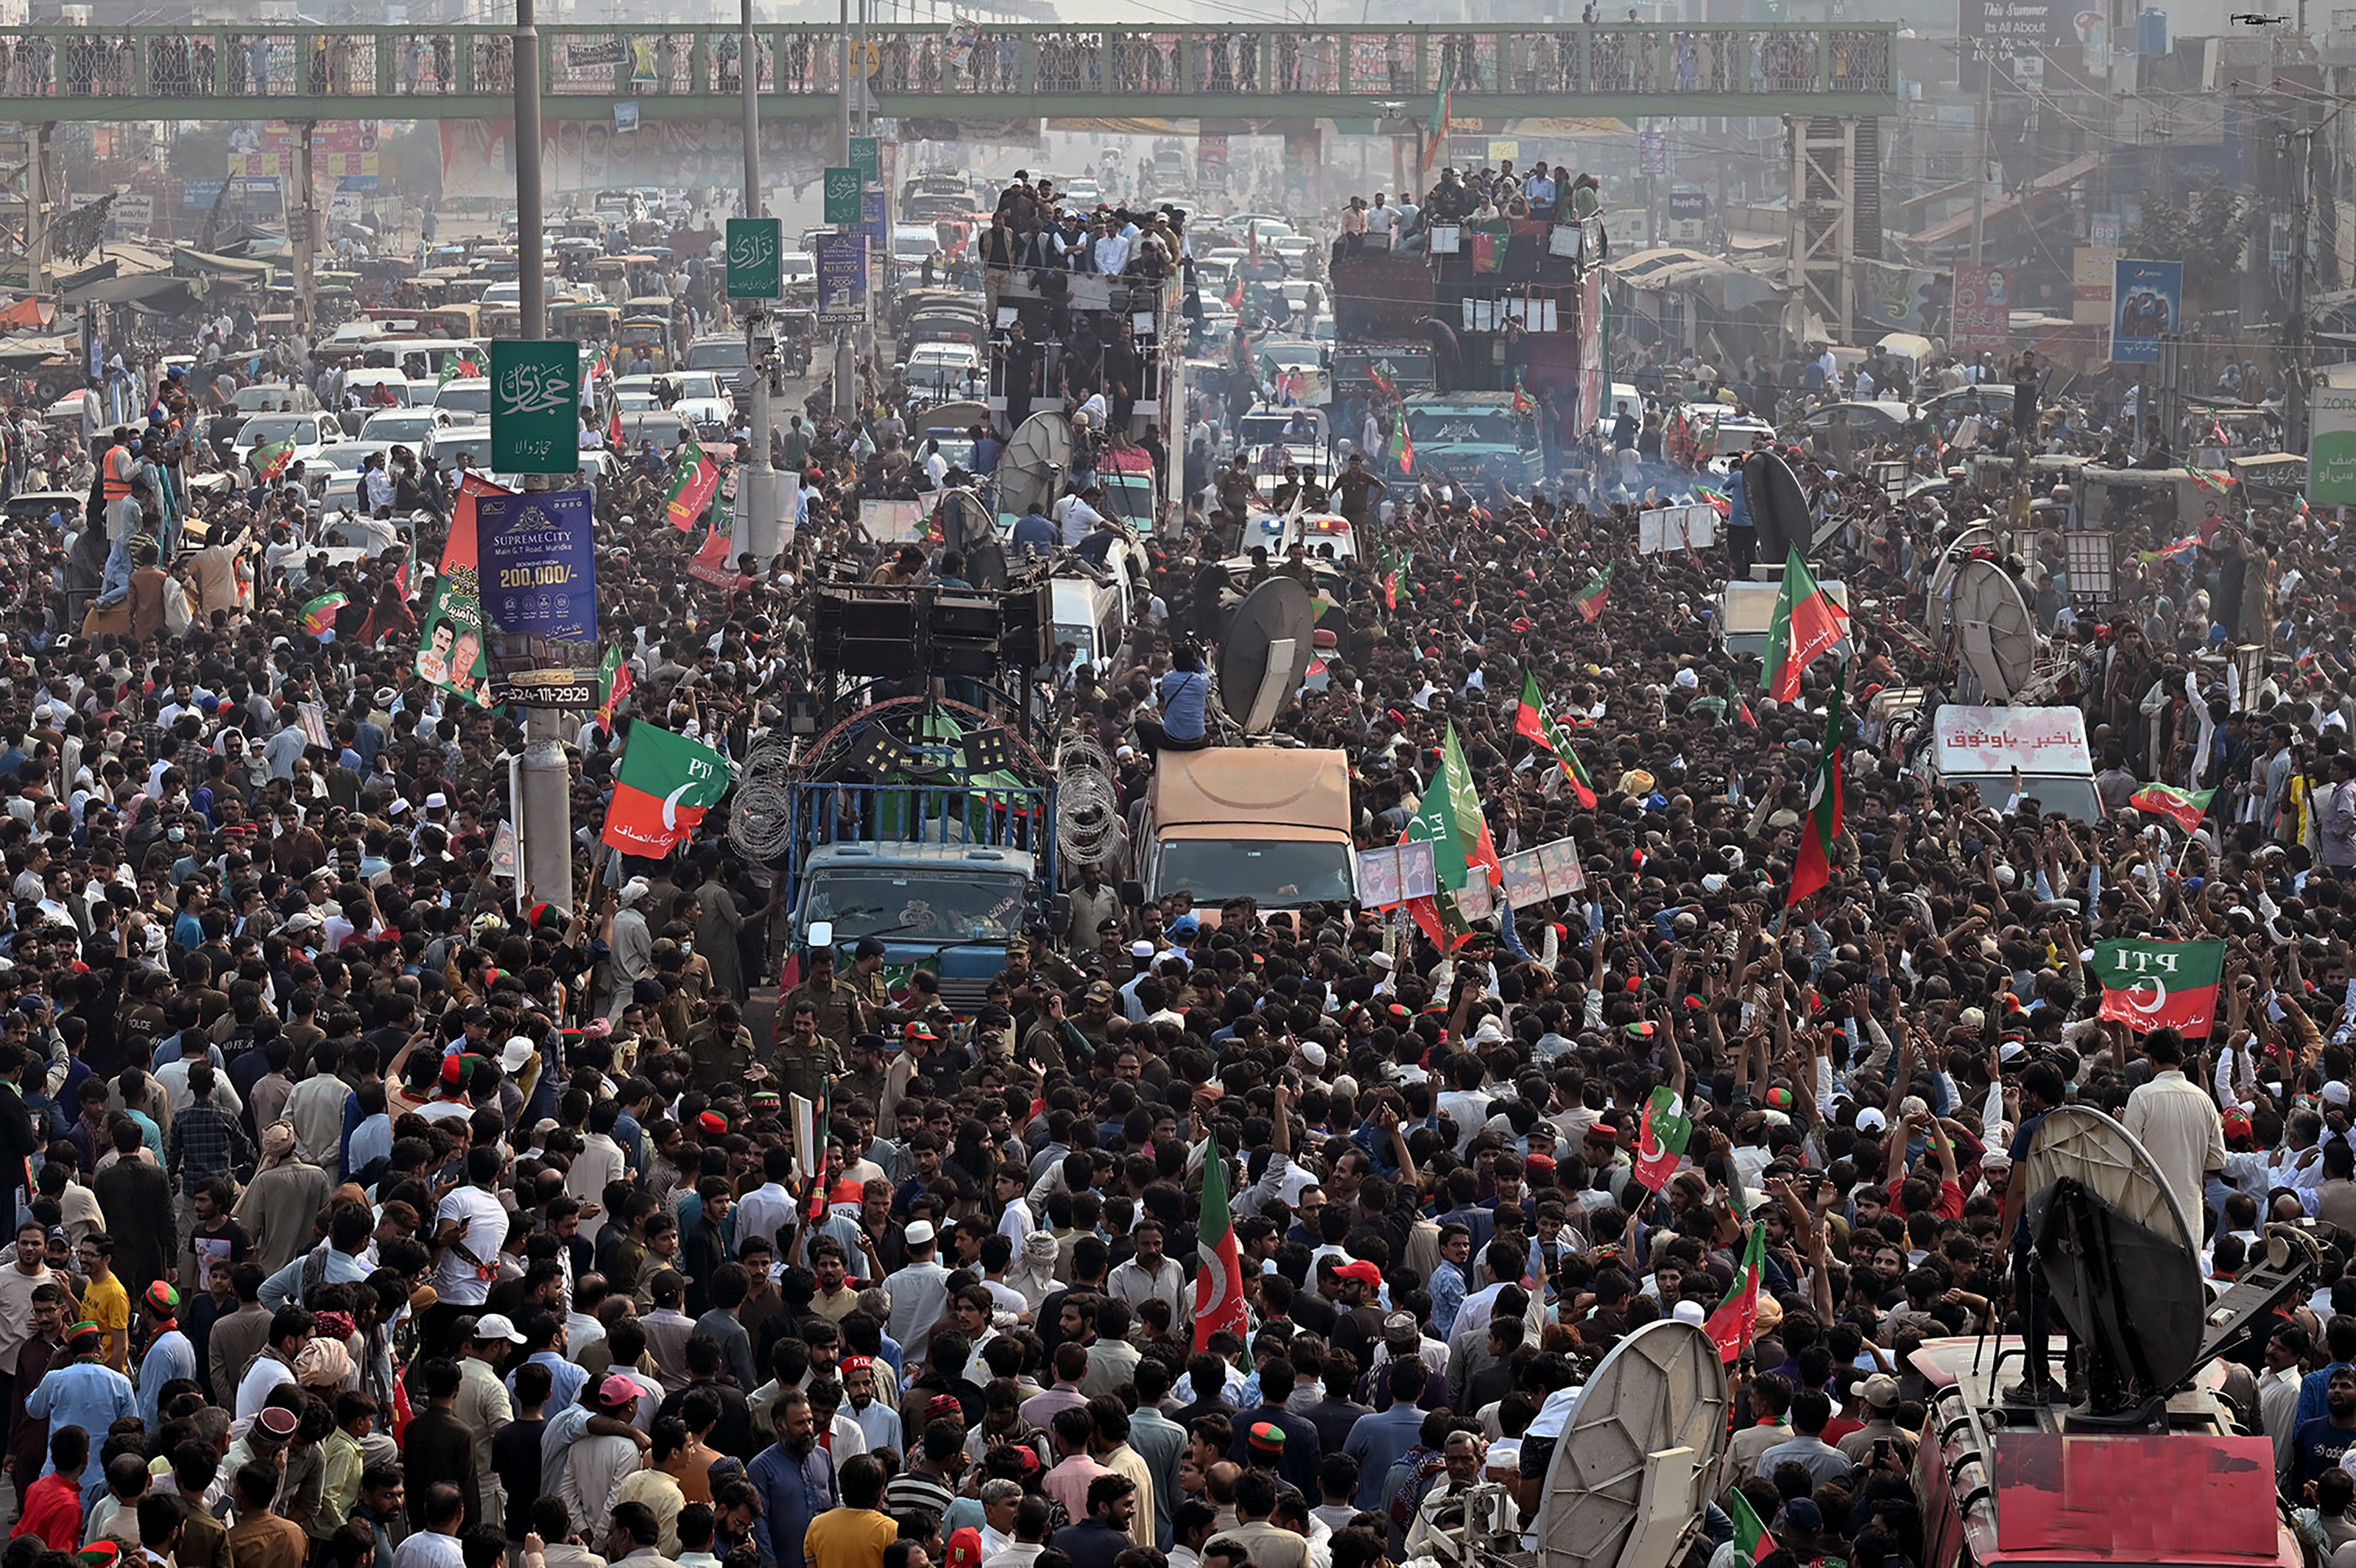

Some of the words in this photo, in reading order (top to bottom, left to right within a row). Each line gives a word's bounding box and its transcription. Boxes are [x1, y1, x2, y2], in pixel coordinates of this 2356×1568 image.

[1983, 2, 2004, 16] This
[1999, 22, 2012, 33] All
[2013, 22, 2046, 33] About
[495, 548, 511, 556] Main
[546, 543, 572, 552] Muridke
[500, 565, 578, 589] 200,000/-
[2031, 731, 2082, 749] باخبر
[1429, 813, 1447, 841] PTI
